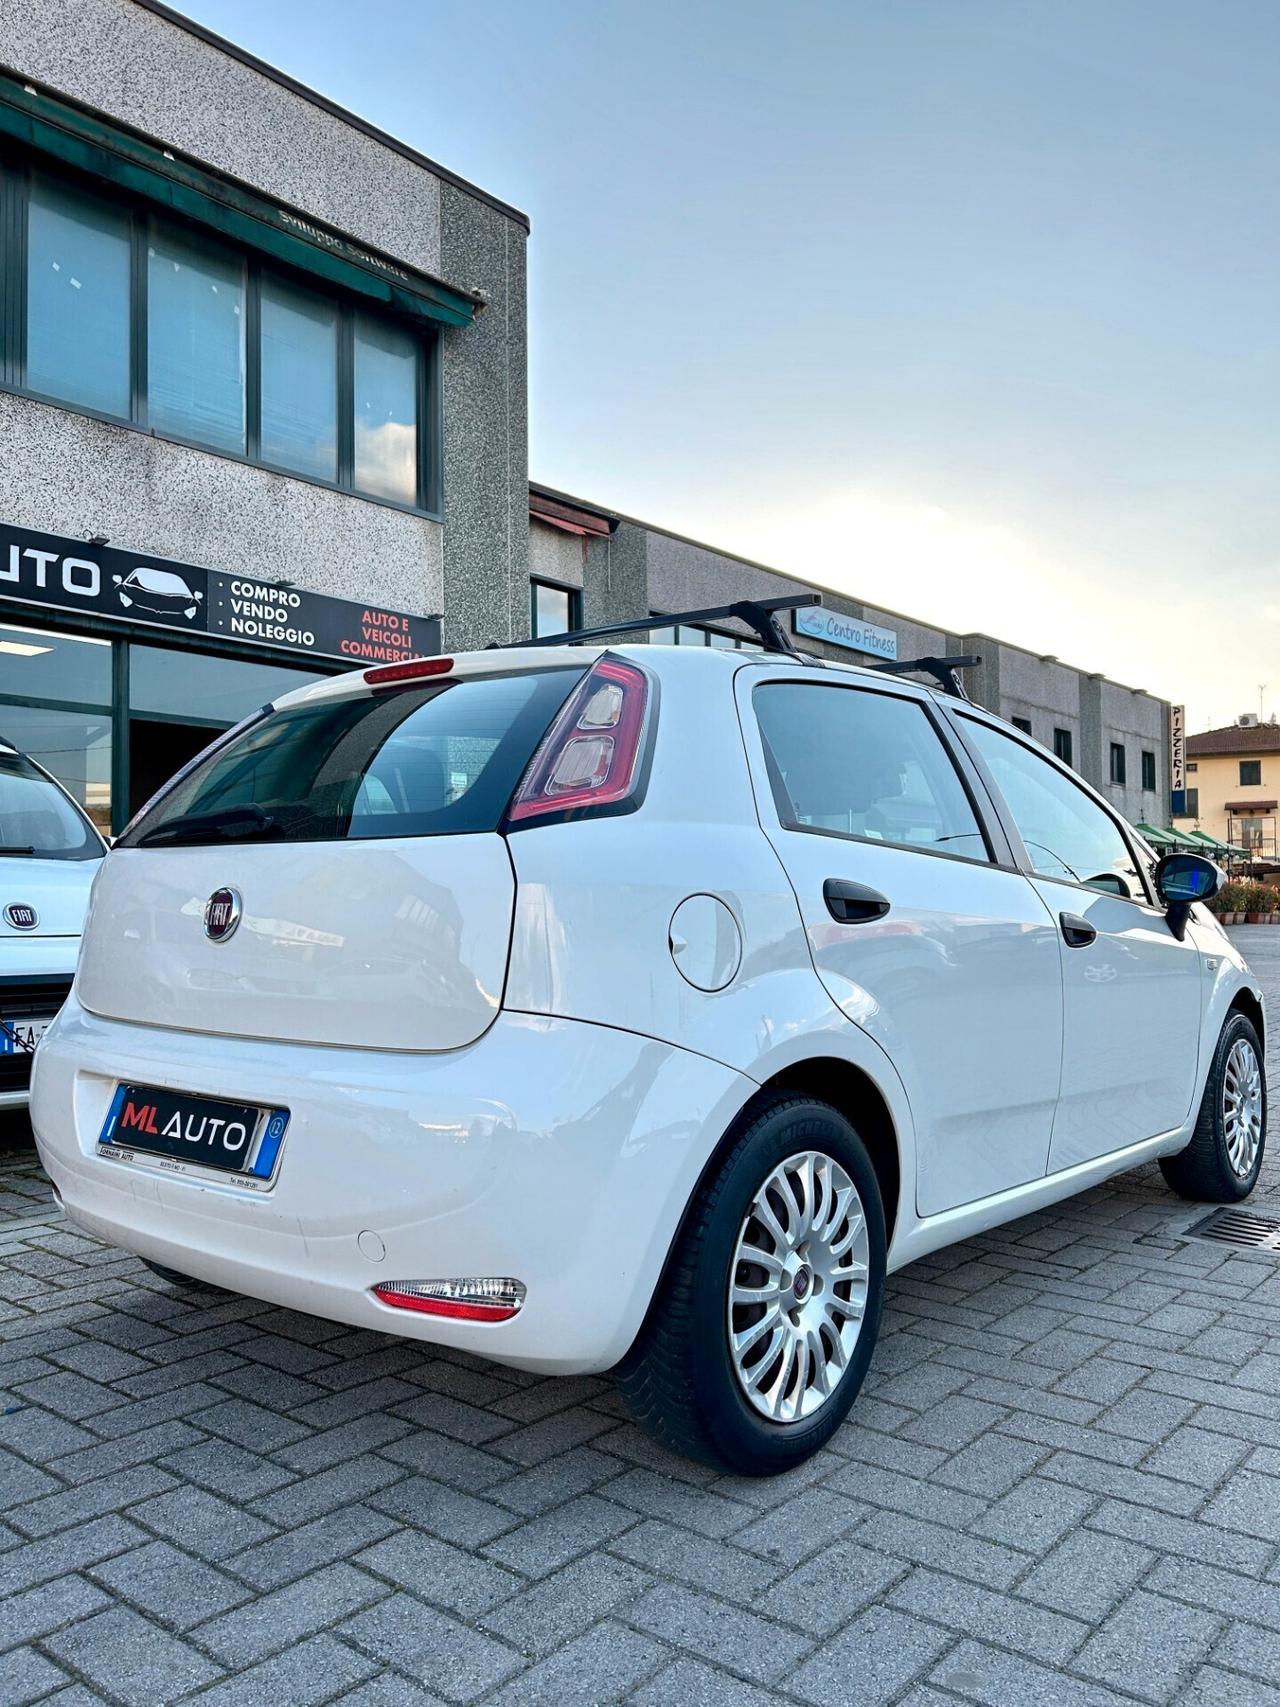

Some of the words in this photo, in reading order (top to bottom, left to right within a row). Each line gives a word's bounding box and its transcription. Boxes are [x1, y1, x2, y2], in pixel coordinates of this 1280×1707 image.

[230, 580, 301, 608] COMPRO
[230, 598, 288, 623] VENDO
[361, 610, 399, 629] AUTO
[402, 618, 409, 631] E
[230, 618, 316, 647] NOLEGGIO
[361, 626, 412, 649] VEICOLI
[826, 616, 862, 643] Centro
[863, 628, 896, 653] Fitness
[1172, 706, 1182, 789] PIZZERIA
[11, 909, 33, 922] FIAT
[210, 903, 231, 925] FIAT
[161, 1111, 246, 1150] AUTO
